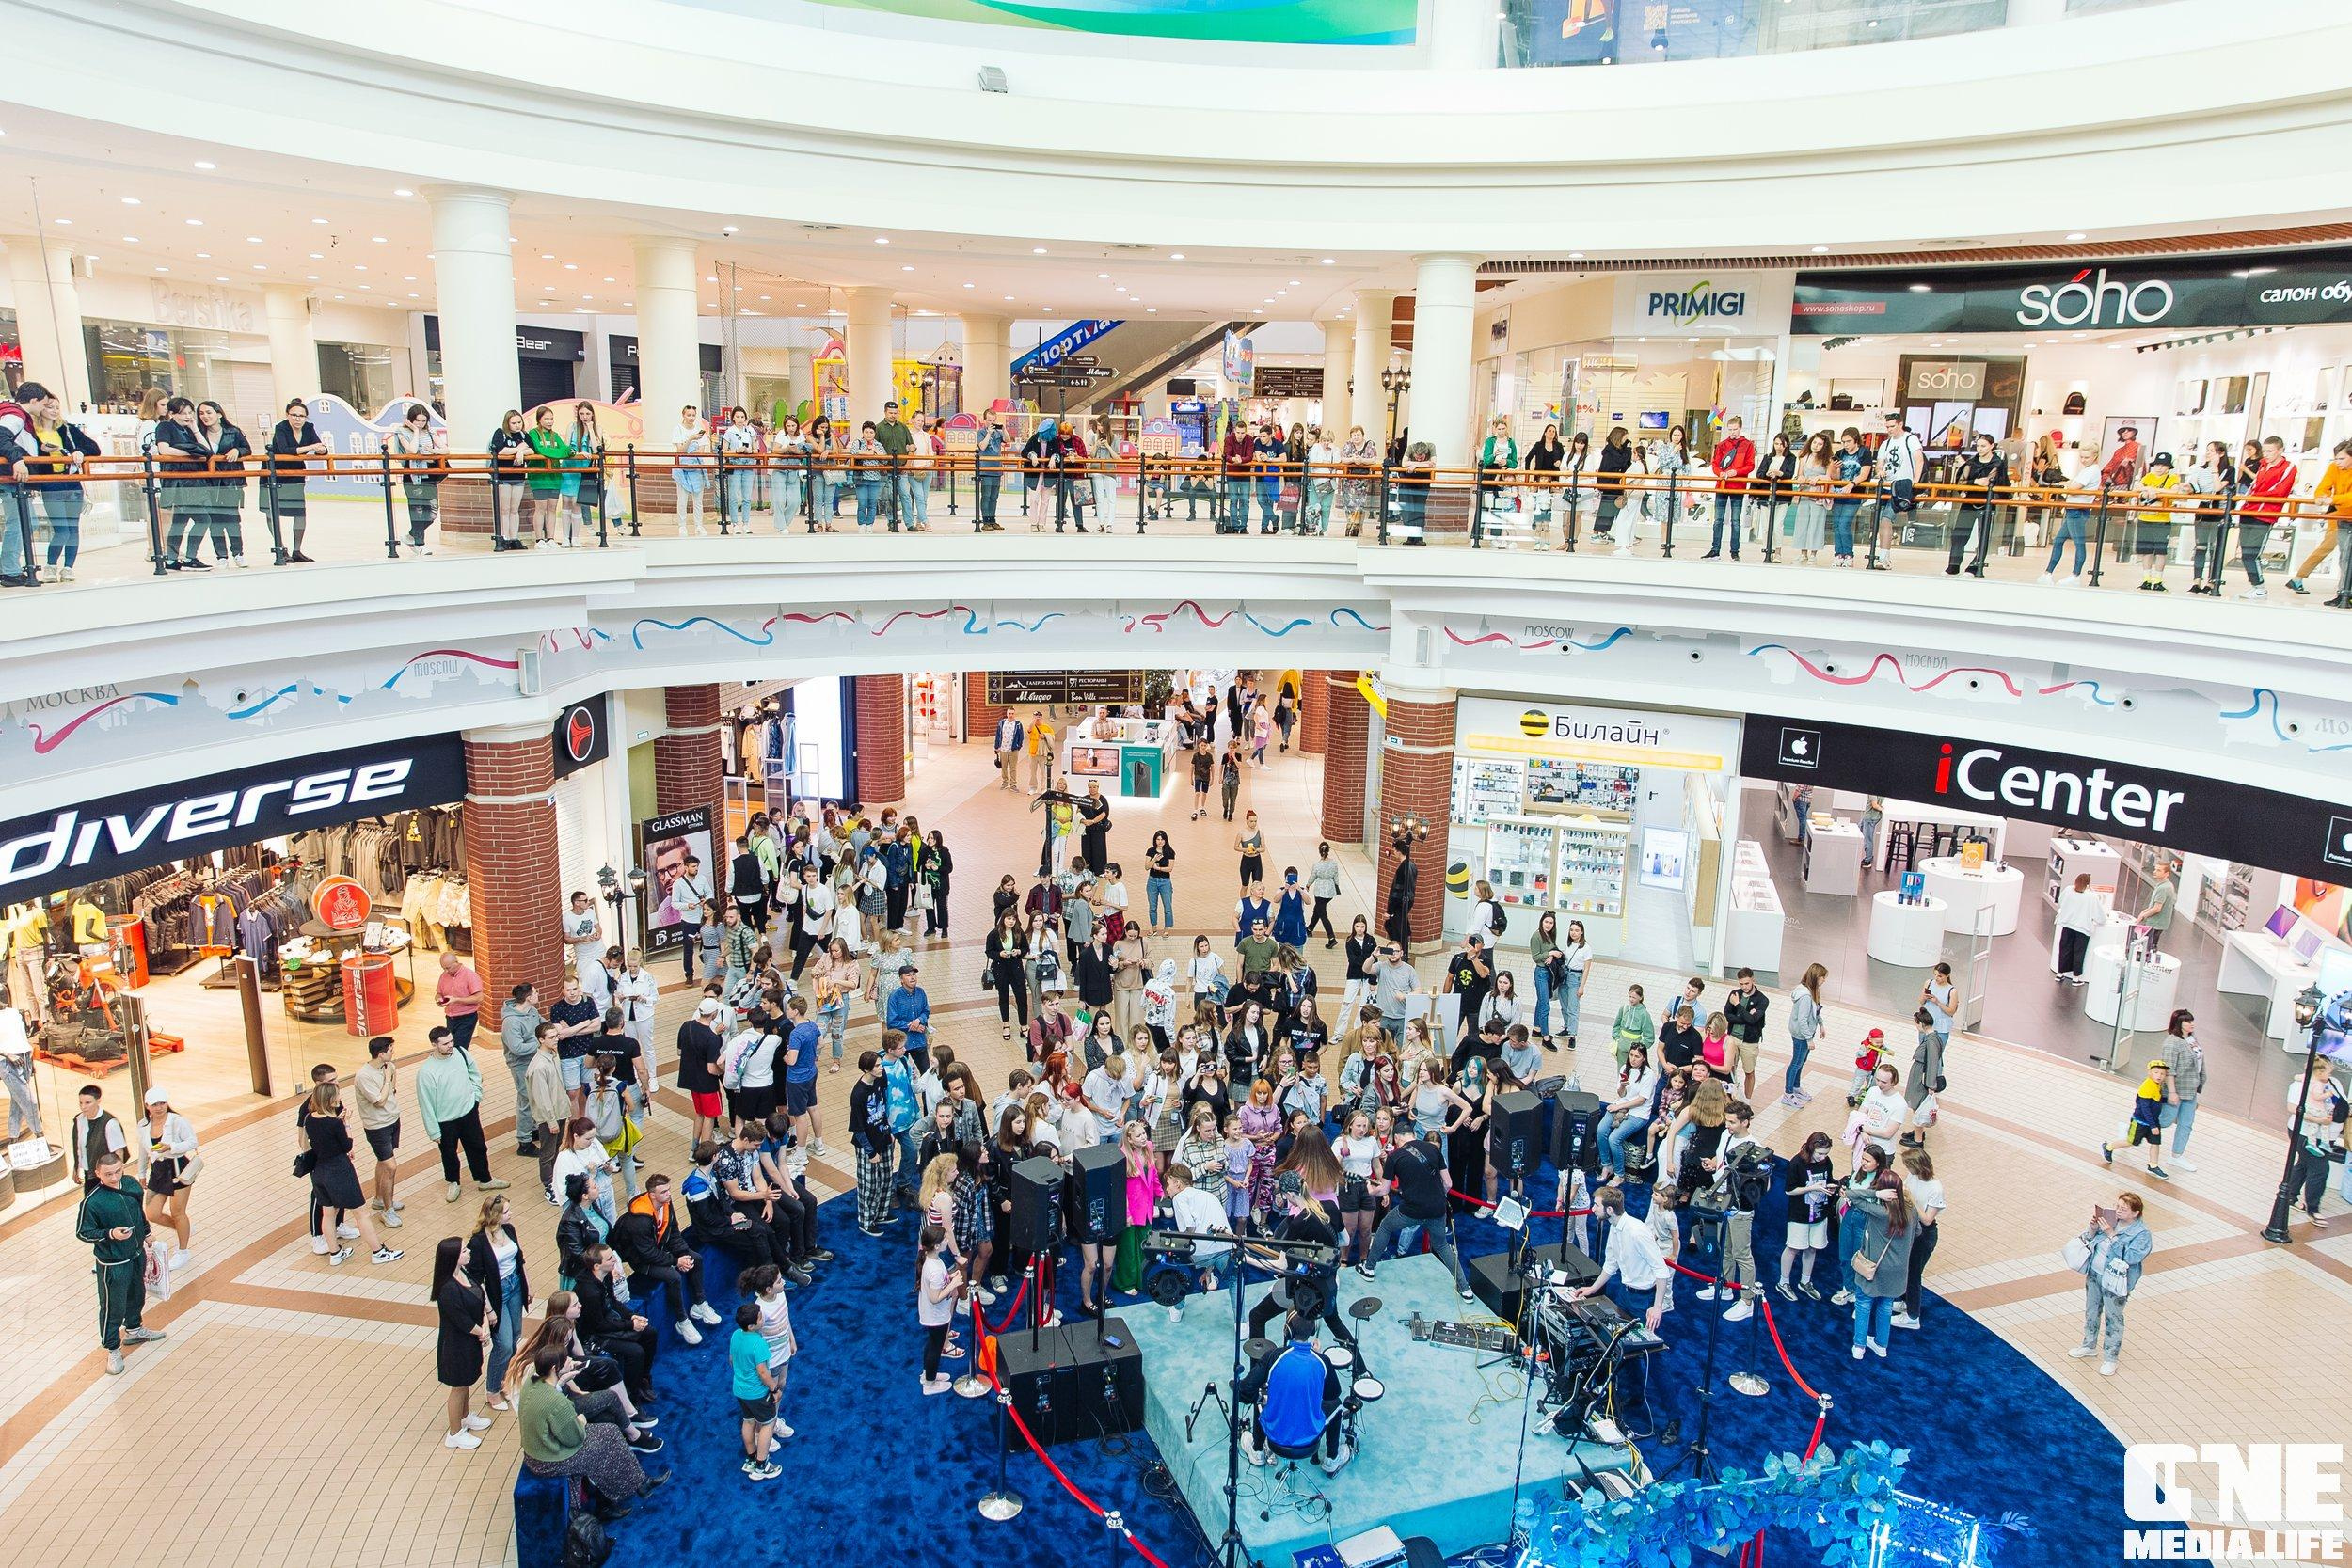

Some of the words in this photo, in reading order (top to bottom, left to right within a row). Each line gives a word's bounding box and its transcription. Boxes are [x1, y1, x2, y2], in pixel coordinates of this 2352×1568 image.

[1648, 292, 1746, 317] PRIMIGI
[2260, 286, 2318, 303] салон
[1802, 305, 1875, 314] www.sohoshop.ru
[1524, 625, 1575, 640] MOSCOW
[414, 659, 458, 677] MOSCOW
[1905, 653, 1948, 670] МОСКВА
[25, 683, 120, 713] МОСКВА
[1555, 715, 1659, 746] Билайн
[1935, 743, 2185, 832] iCenter
[0, 758, 413, 886] diverse
[651, 812, 704, 832] GLASSMAN
[351, 968, 369, 1037] diverse
